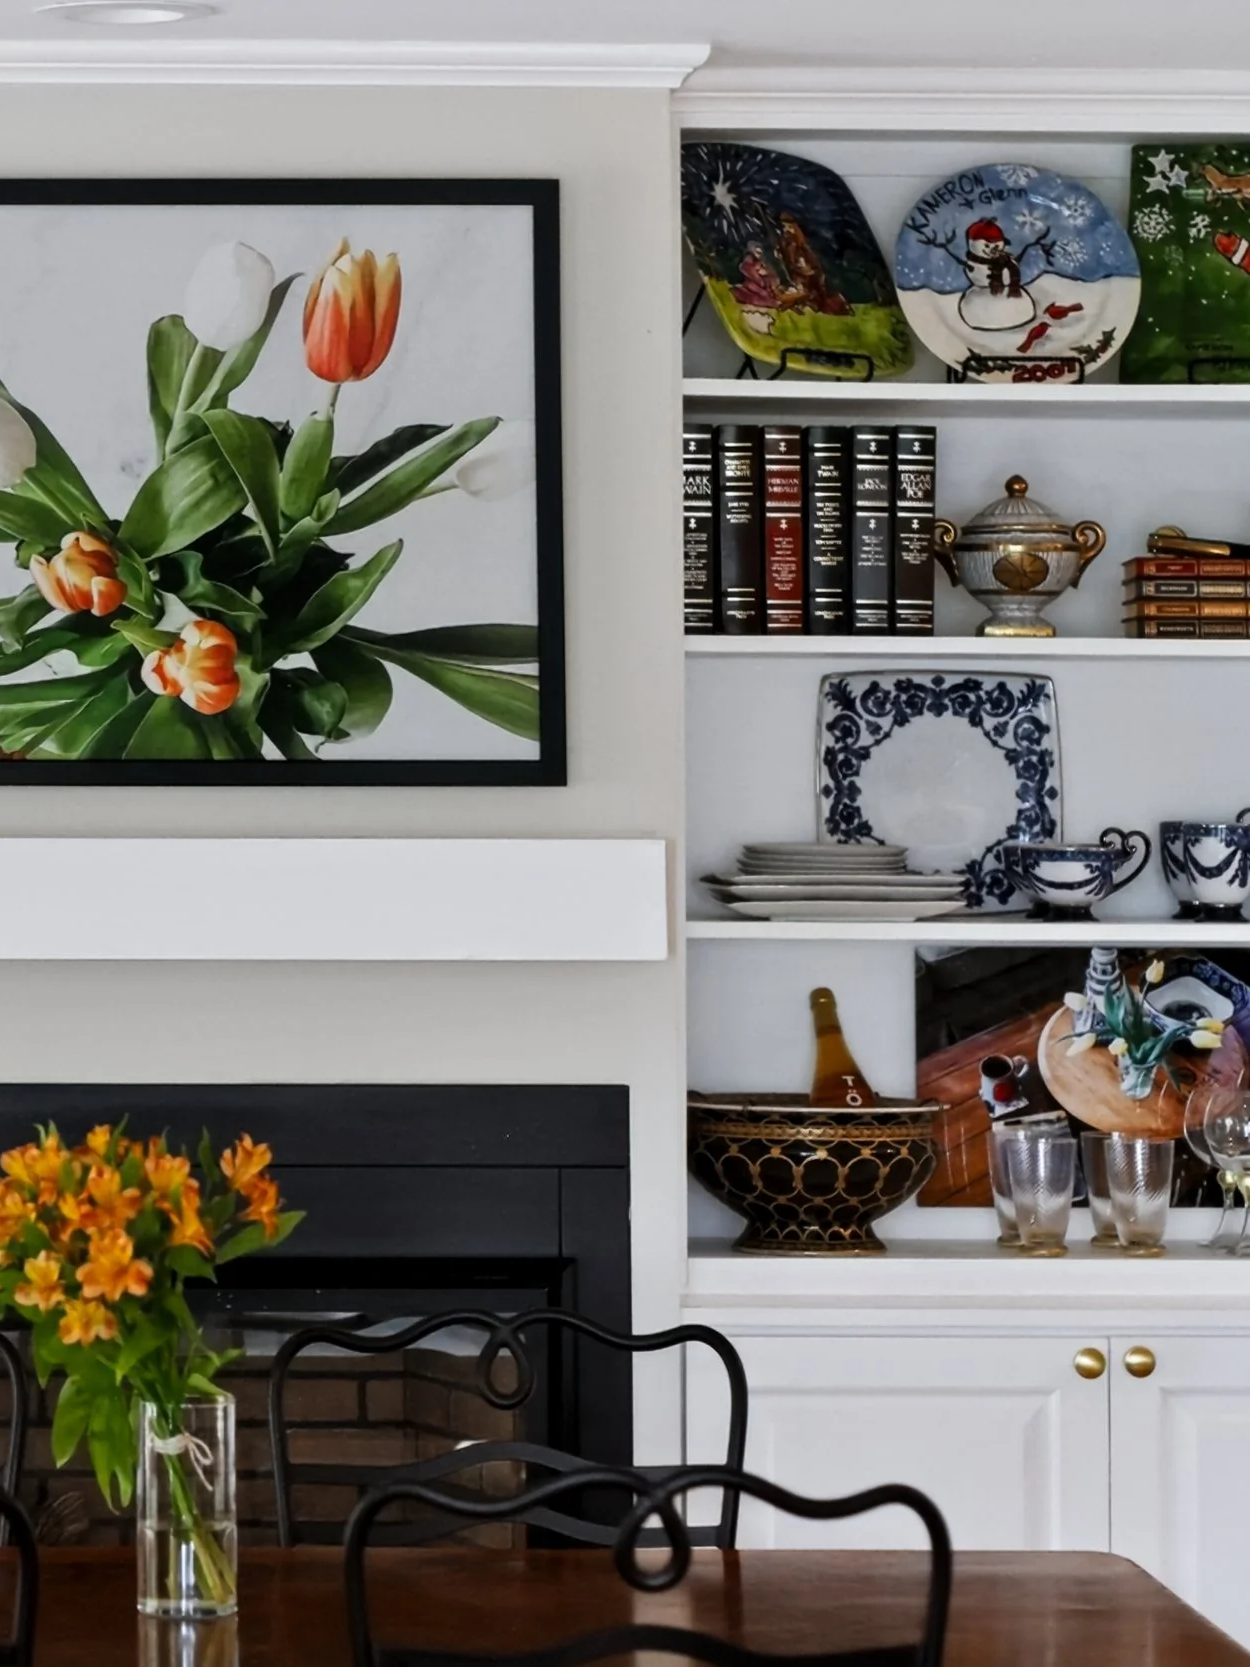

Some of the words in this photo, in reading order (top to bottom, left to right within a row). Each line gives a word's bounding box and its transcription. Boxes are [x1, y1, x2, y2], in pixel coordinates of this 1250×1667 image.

[978, 187, 1028, 206] Glenn
[905, 171, 986, 234] KAMERON
[683, 475, 710, 485] ARK
[901, 473, 931, 481] EDGAR
[900, 481, 931, 490] ALLAN
[907, 489, 924, 498] POE
